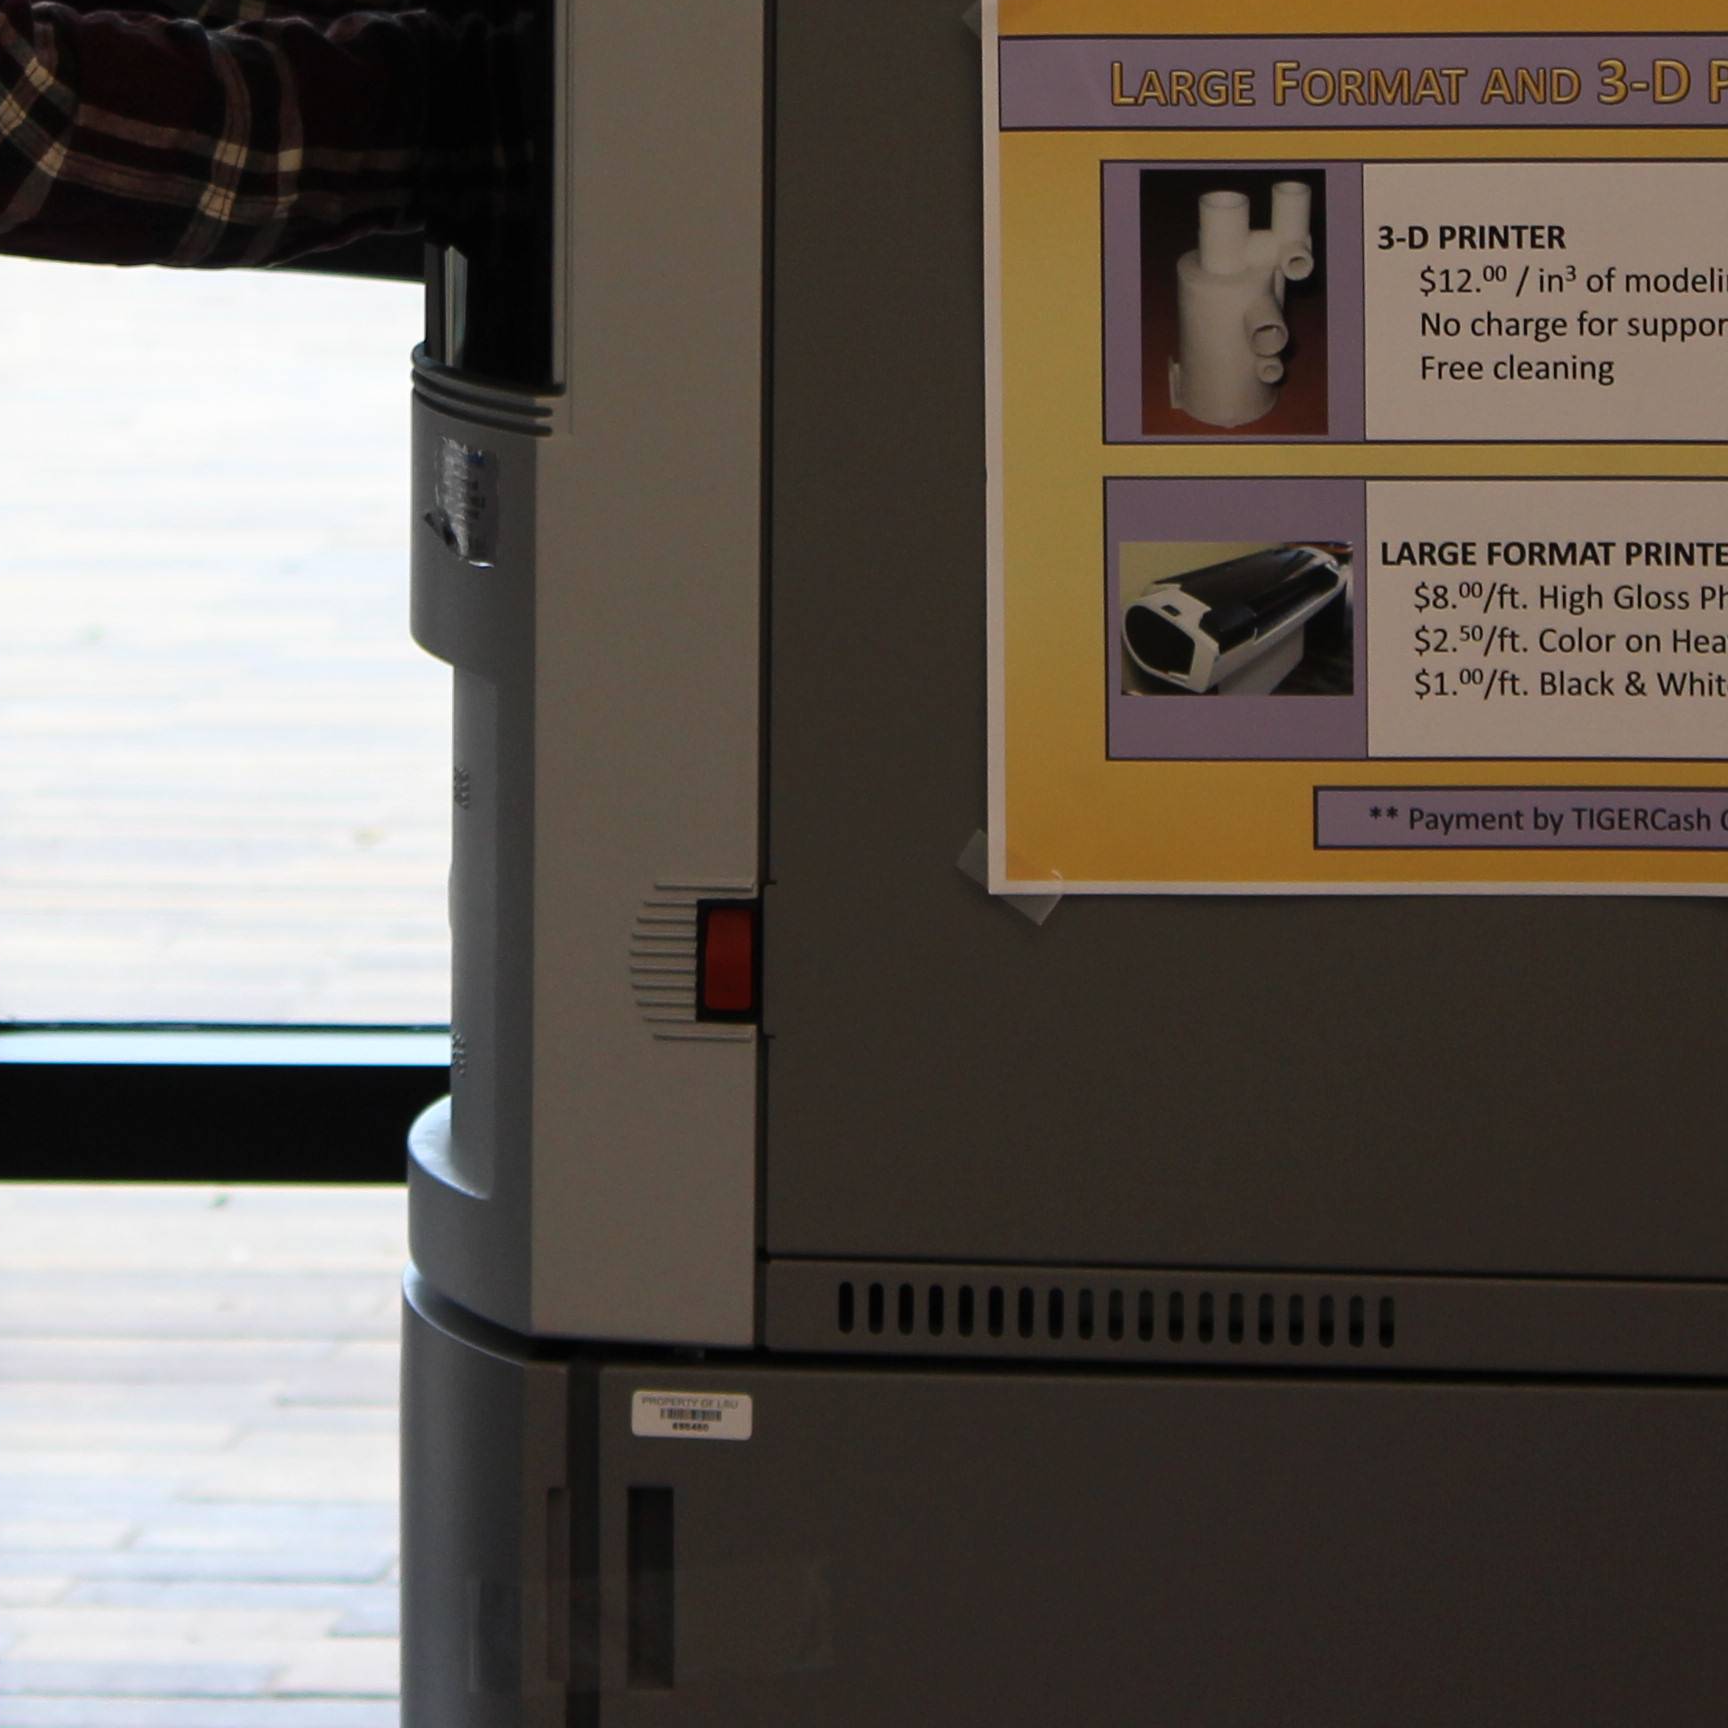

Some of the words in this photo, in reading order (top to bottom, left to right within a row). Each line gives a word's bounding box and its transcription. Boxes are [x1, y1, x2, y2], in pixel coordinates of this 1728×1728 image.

[1110, 60, 1257, 108] LARGE
[1272, 59, 1469, 107] FORMAT
[1479, 66, 1582, 106] AND
[1596, 57, 1692, 106] 3-D
[1377, 225, 1429, 251] 3-D
[1439, 224, 1567, 250] PRINTER
[1515, 265, 1530, 298] /
[1586, 266, 1617, 294] of
[1421, 312, 1461, 337] No
[1470, 310, 1568, 343] charge
[1576, 309, 1619, 337] for
[1421, 355, 1484, 381] Free
[1493, 353, 1615, 387] cleaning
[1381, 541, 1477, 567] LARGE
[1487, 541, 1617, 567] FORMAT
[1539, 583, 1603, 616] High
[1613, 583, 1690, 611] Gloss
[1538, 626, 1617, 653] Color
[1625, 633, 1661, 653] on
[1540, 669, 1615, 697] Black
[1624, 670, 1648, 697] &
[1409, 807, 1525, 836] Payment
[1533, 806, 1565, 837] by
[1571, 807, 1712, 832] TIGERCash
